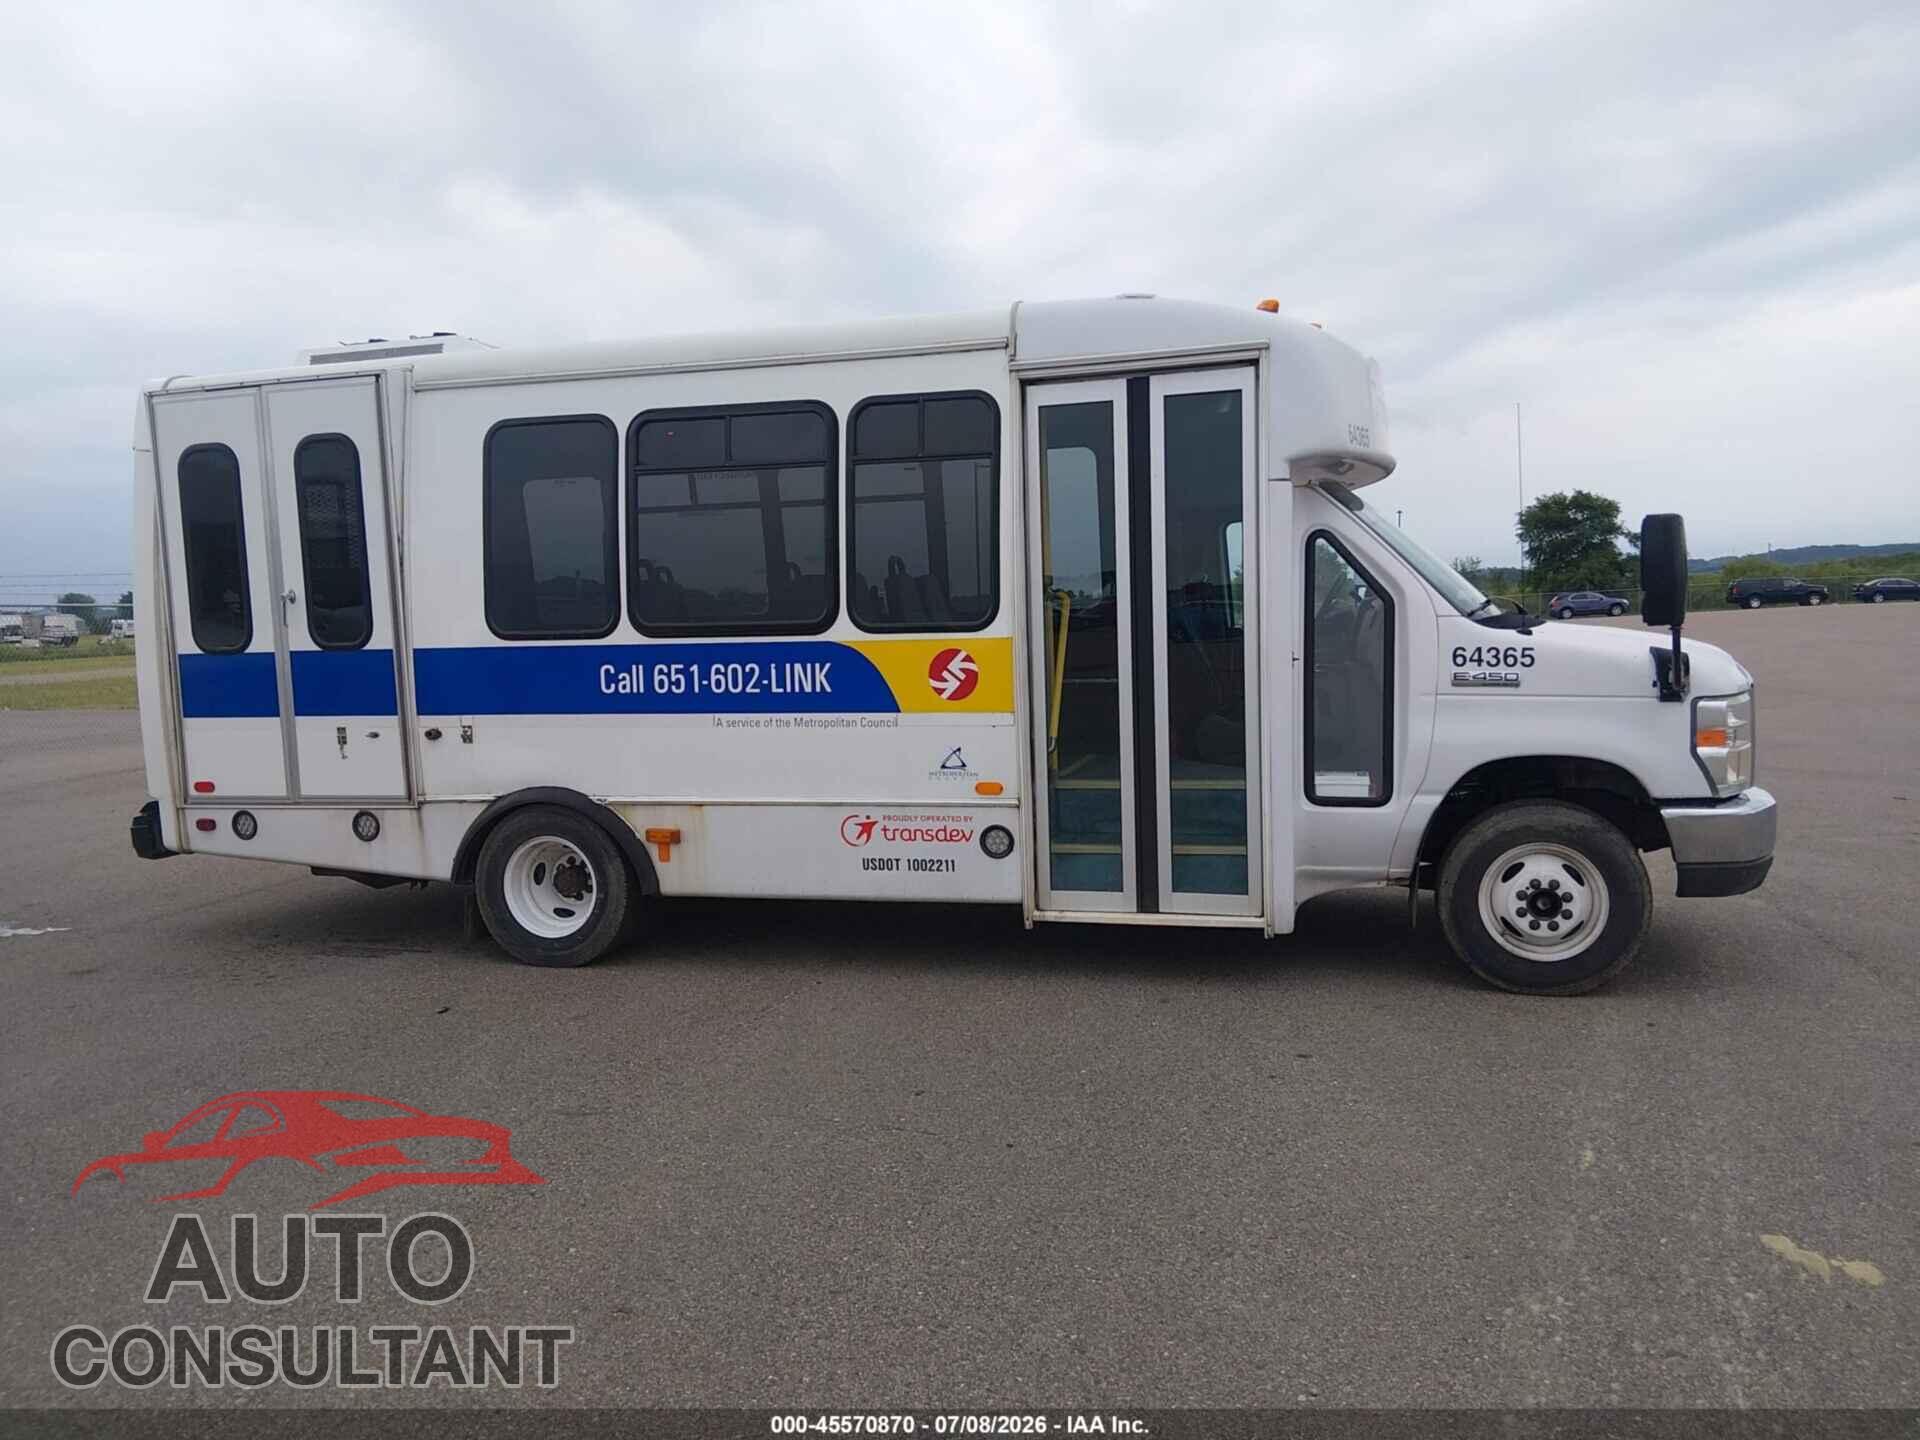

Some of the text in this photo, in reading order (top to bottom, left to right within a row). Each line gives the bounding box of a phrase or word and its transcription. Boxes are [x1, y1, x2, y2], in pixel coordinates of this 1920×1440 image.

[1452, 646, 1535, 668] 64365
[600, 662, 832, 694] Call 651-602-LINK
[726, 717, 760, 728] service
[763, 717, 774, 728] of
[775, 717, 791, 728] the
[794, 716, 858, 729] Metropolitan
[860, 716, 898, 728] Council
[882, 814, 919, 822] PROUDLY
[920, 815, 962, 823] OPERATED
[881, 825, 974, 843] transdev
[862, 857, 956, 873] USDOT 1002211
